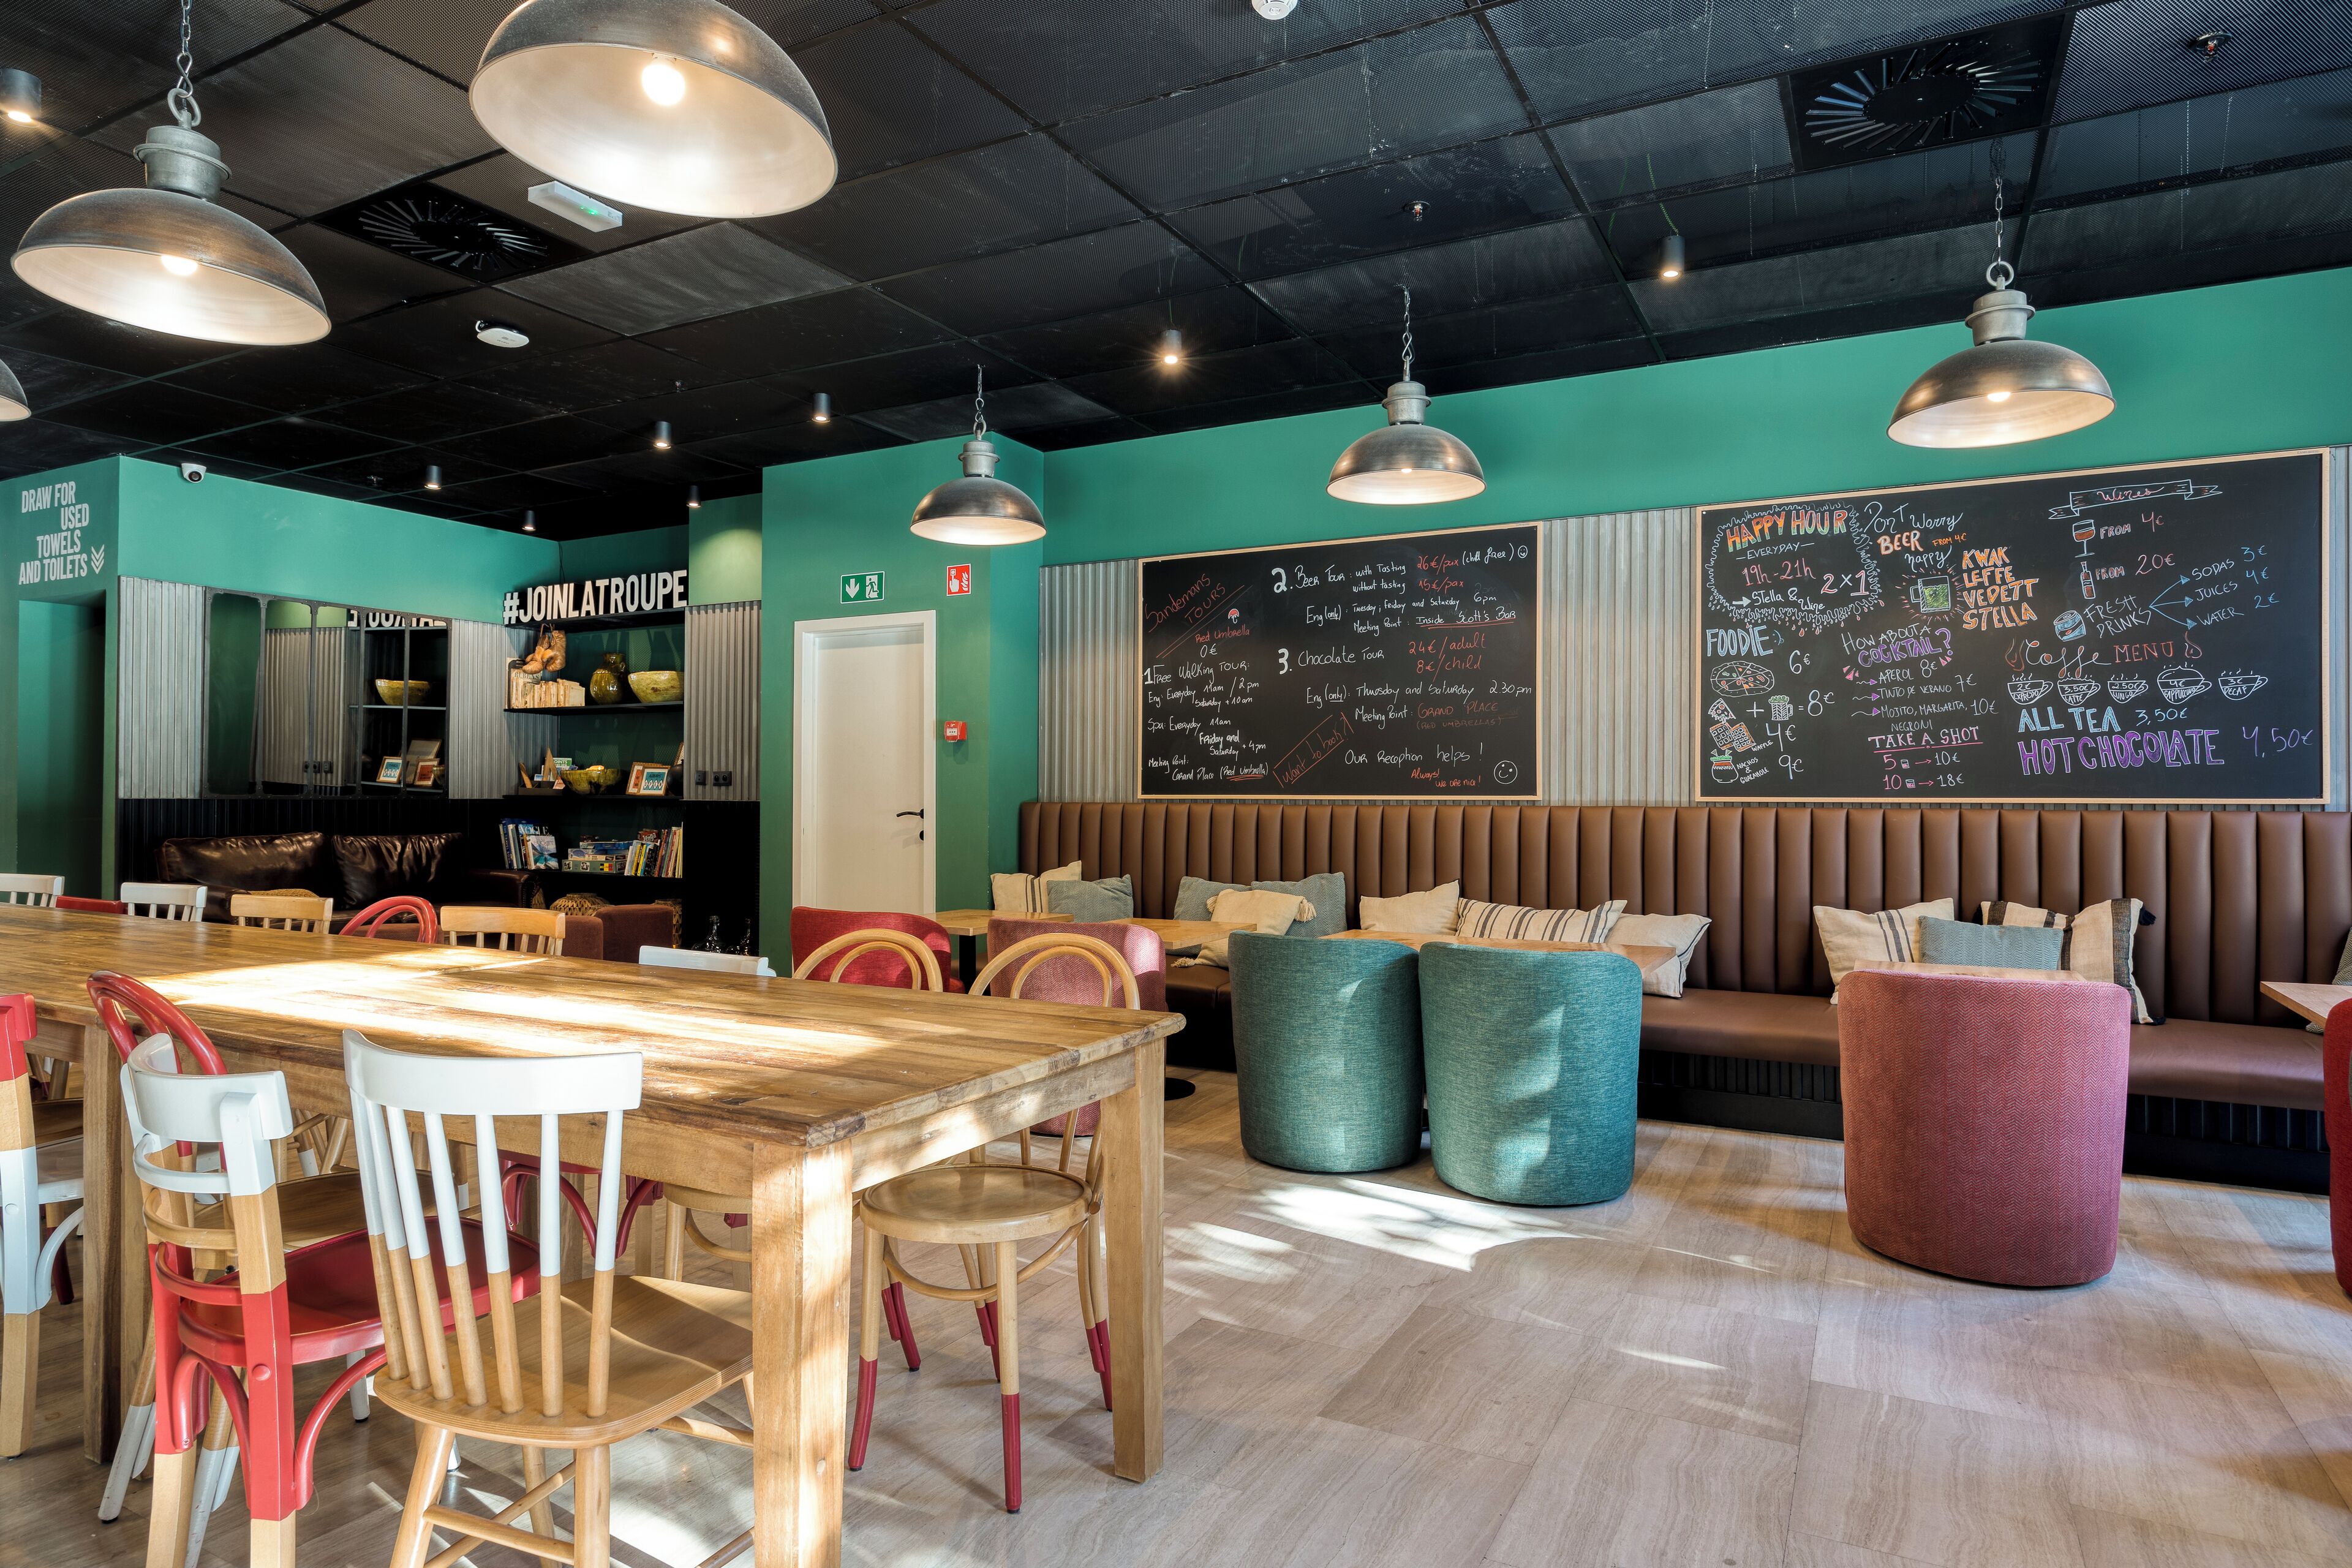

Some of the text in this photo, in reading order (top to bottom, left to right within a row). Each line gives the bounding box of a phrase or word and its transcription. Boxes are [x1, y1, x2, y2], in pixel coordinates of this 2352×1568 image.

[21, 481, 76, 513] DRAW FOR
[2097, 486, 2165, 502] Wines
[61, 503, 89, 530] USED
[1726, 510, 1848, 552] HAPPY HOUR
[2100, 523, 2131, 540] FROM
[37, 529, 81, 559] TOWELS
[1876, 530, 1924, 555] BEER
[1932, 537, 1953, 547] FROM
[18, 553, 88, 585] AND TOILETS
[1962, 546, 2010, 570] KWAK
[2095, 553, 2176, 581] FROM 20€
[1355, 564, 1372, 578] with
[1962, 565, 2016, 588] LEFFE
[2192, 558, 2235, 581] SODAS
[1352, 579, 1378, 592] without
[1380, 578, 1406, 594] tasting
[1787, 587, 1798, 602] &
[1962, 578, 2040, 609] VEDETT
[2195, 581, 2238, 601] JUICES
[503, 570, 687, 625] #JOINLATROUPE
[1145, 573, 1210, 633] Sandemans
[1185, 582, 1226, 624] TOURS
[2082, 594, 2138, 623] FRESH
[1306, 605, 1324, 627] Eng
[1412, 598, 1425, 608] and
[1430, 595, 1460, 611] Saturday
[1962, 602, 2038, 631] STELLA
[2196, 606, 2245, 626] WATER
[1354, 619, 1379, 636] Meeting
[1415, 614, 1445, 625] Inside
[1456, 609, 1490, 624] Scott's
[2096, 606, 2152, 639] DRINKS
[1195, 631, 1210, 643] Red
[1298, 645, 1357, 667] Chocolate
[2113, 641, 2174, 663] MENU
[1878, 668, 1914, 685] APEROL
[1306, 687, 1323, 709] Eng
[1405, 681, 1423, 695] and
[1428, 680, 1474, 704] Saturday
[1877, 687, 1905, 699] TINTO
[1919, 684, 1952, 694] VERANO
[2013, 690, 2039, 702] EXPRESSO
[2064, 695, 2083, 704] LATTE
[2112, 690, 2133, 700] LUNGO
[2223, 686, 2247, 696] DECAF
[1210, 717, 1231, 726] 11am
[1355, 705, 1385, 729] Meeting
[1466, 700, 1499, 715] PLACE
[1891, 719, 1933, 732] NEGRONI
[2018, 706, 2065, 733] ALL
[2067, 706, 2121, 733] TEA
[1226, 729, 1240, 743] and
[1751, 739, 1774, 752] WAFFLE
[1868, 726, 1979, 748] TAKE A SHOT
[1736, 756, 1759, 770] NACHOS
[1883, 754, 1897, 770] 5
[2017, 737, 2075, 775] HOT
[2077, 729, 2225, 770] CHOCOLATE
[1197, 767, 1215, 781] Place
[1882, 774, 1902, 790] 10
[642, 832, 657, 842] Jenga
